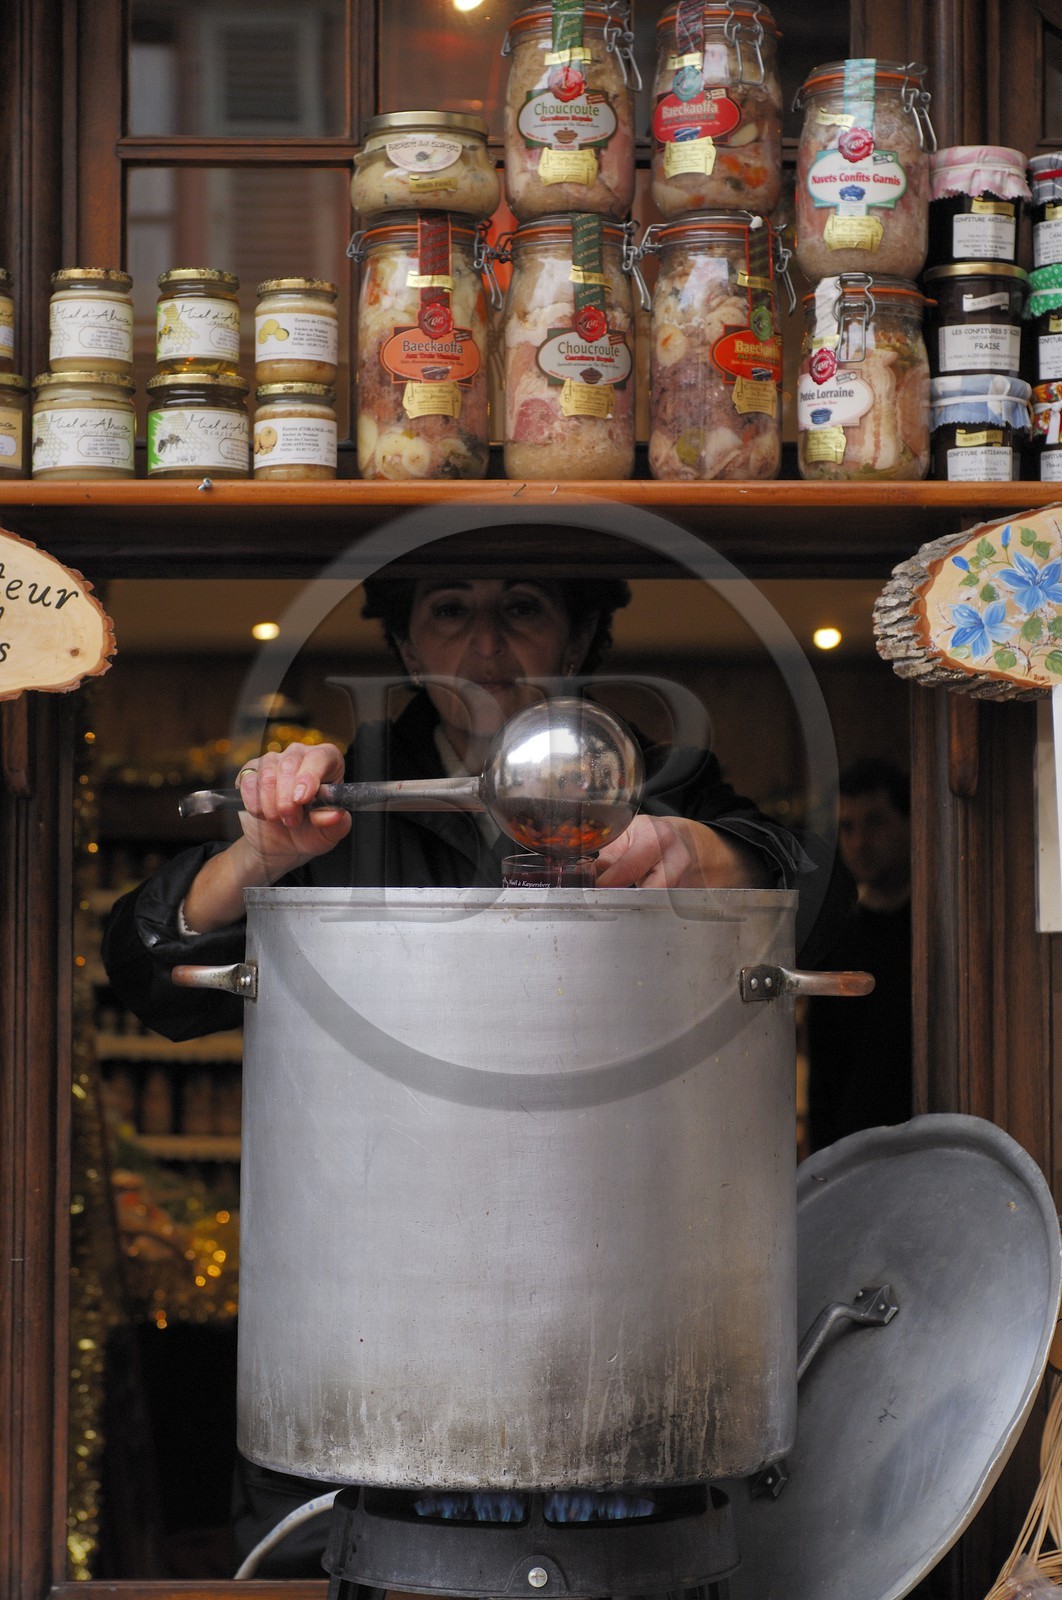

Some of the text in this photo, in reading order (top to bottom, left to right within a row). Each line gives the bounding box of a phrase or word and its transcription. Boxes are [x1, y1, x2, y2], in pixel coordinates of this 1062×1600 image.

[534, 102, 600, 116] Choucroute
[812, 172, 901, 186] Navets Confits Garnis
[952, 327, 962, 336] LES
[964, 327, 1002, 335] CONFITURES
[402, 340, 464, 354] Baeckaoffa
[557, 341, 620, 357] Choucroute
[974, 342, 1000, 350] FRAISE
[816, 386, 855, 400] Lorraine
